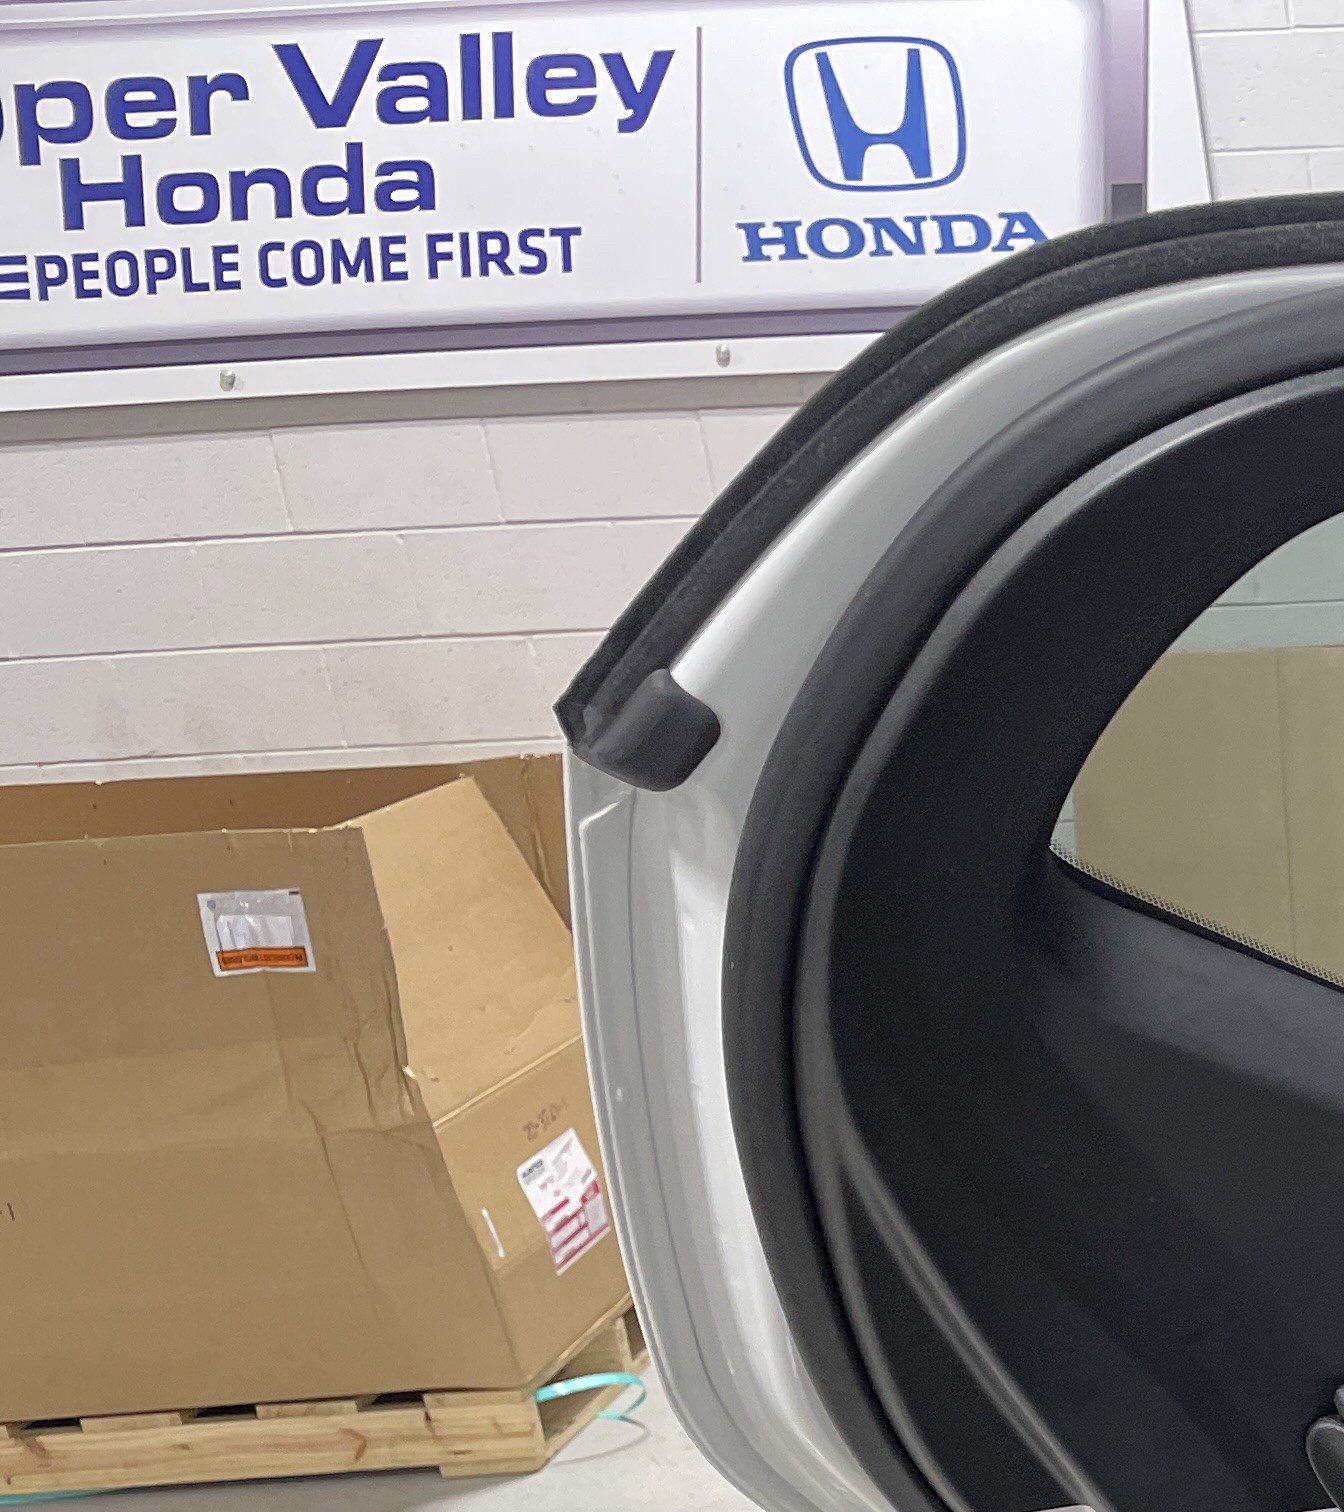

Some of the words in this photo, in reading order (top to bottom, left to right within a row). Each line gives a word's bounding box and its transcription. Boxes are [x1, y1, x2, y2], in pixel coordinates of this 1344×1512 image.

[0, 72, 250, 166] per
[271, 31, 676, 133] Valley
[59, 142, 436, 231] Honda
[35, 244, 242, 301] PEOPLE
[258, 234, 409, 288] COME
[425, 226, 583, 280] FIRST
[735, 211, 1050, 262] HONDA
